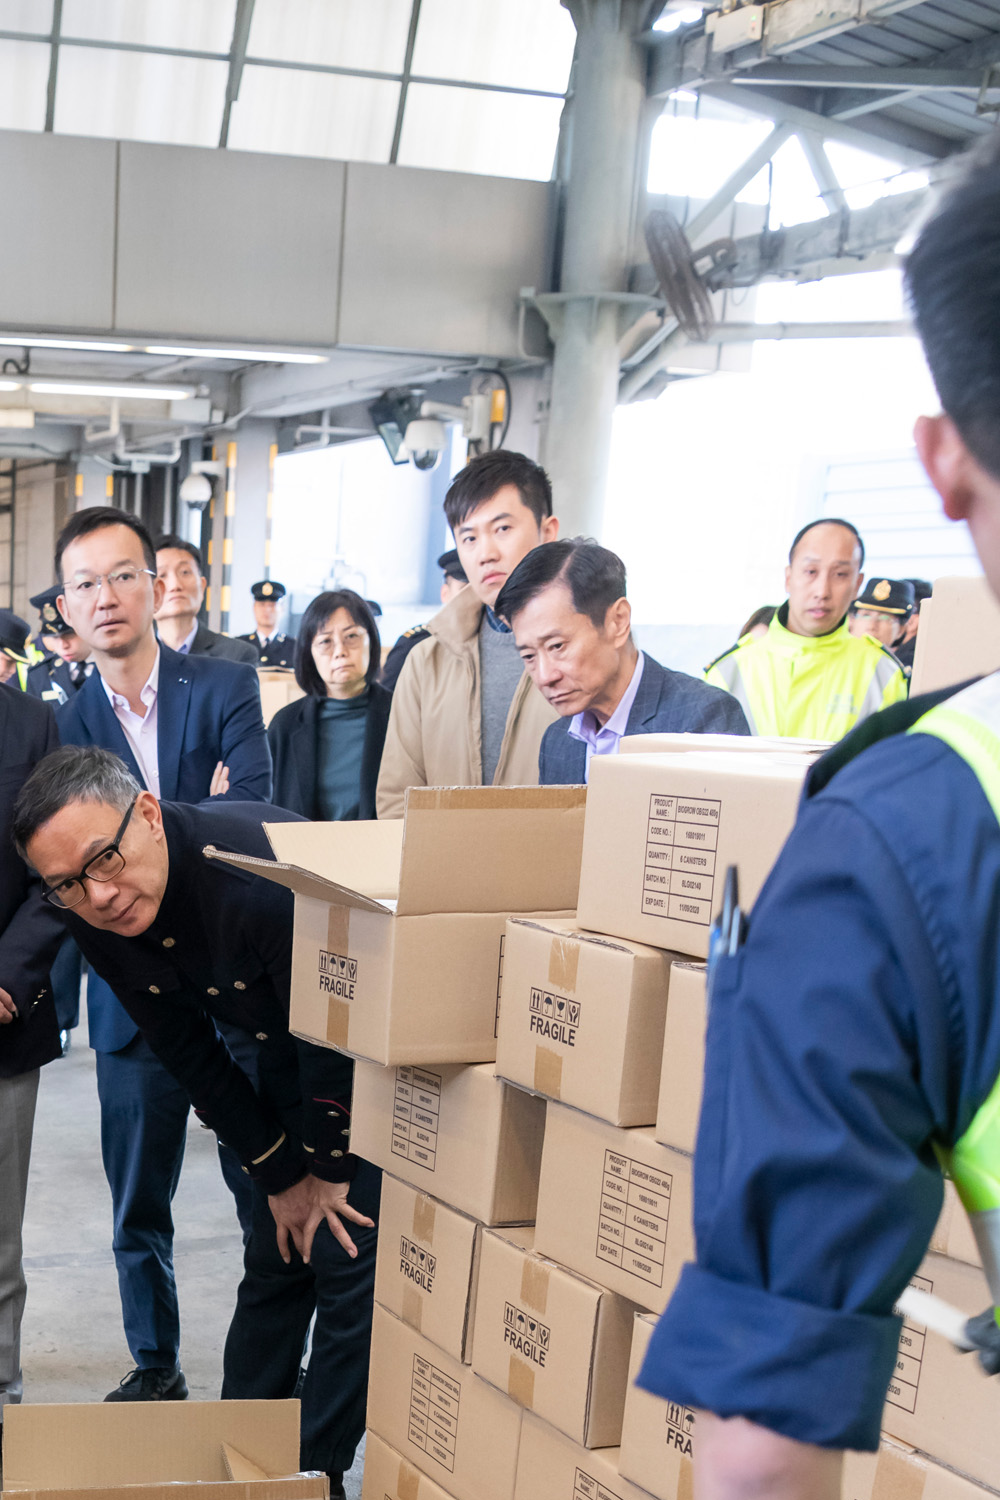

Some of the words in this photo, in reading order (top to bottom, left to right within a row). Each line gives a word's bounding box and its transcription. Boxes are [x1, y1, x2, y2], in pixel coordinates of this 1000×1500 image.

[654, 798, 673, 807] PRODUCT
[656, 809, 667, 817] NAME
[651, 827, 662, 835] CODE
[662, 828, 670, 836] NO.
[648, 851, 668, 861] QUANTITY
[683, 856, 707, 866] CANISTERS
[646, 874, 659, 883] BATCH
[659, 876, 667, 884] NO.
[645, 898, 653, 906] EXP
[653, 899, 664, 908] DATE
[320, 975, 354, 1000] FRAGILE
[530, 1015, 576, 1047] FRAGILE
[400, 1259, 432, 1294] FRAGILE
[504, 1327, 546, 1368] FRAGILE
